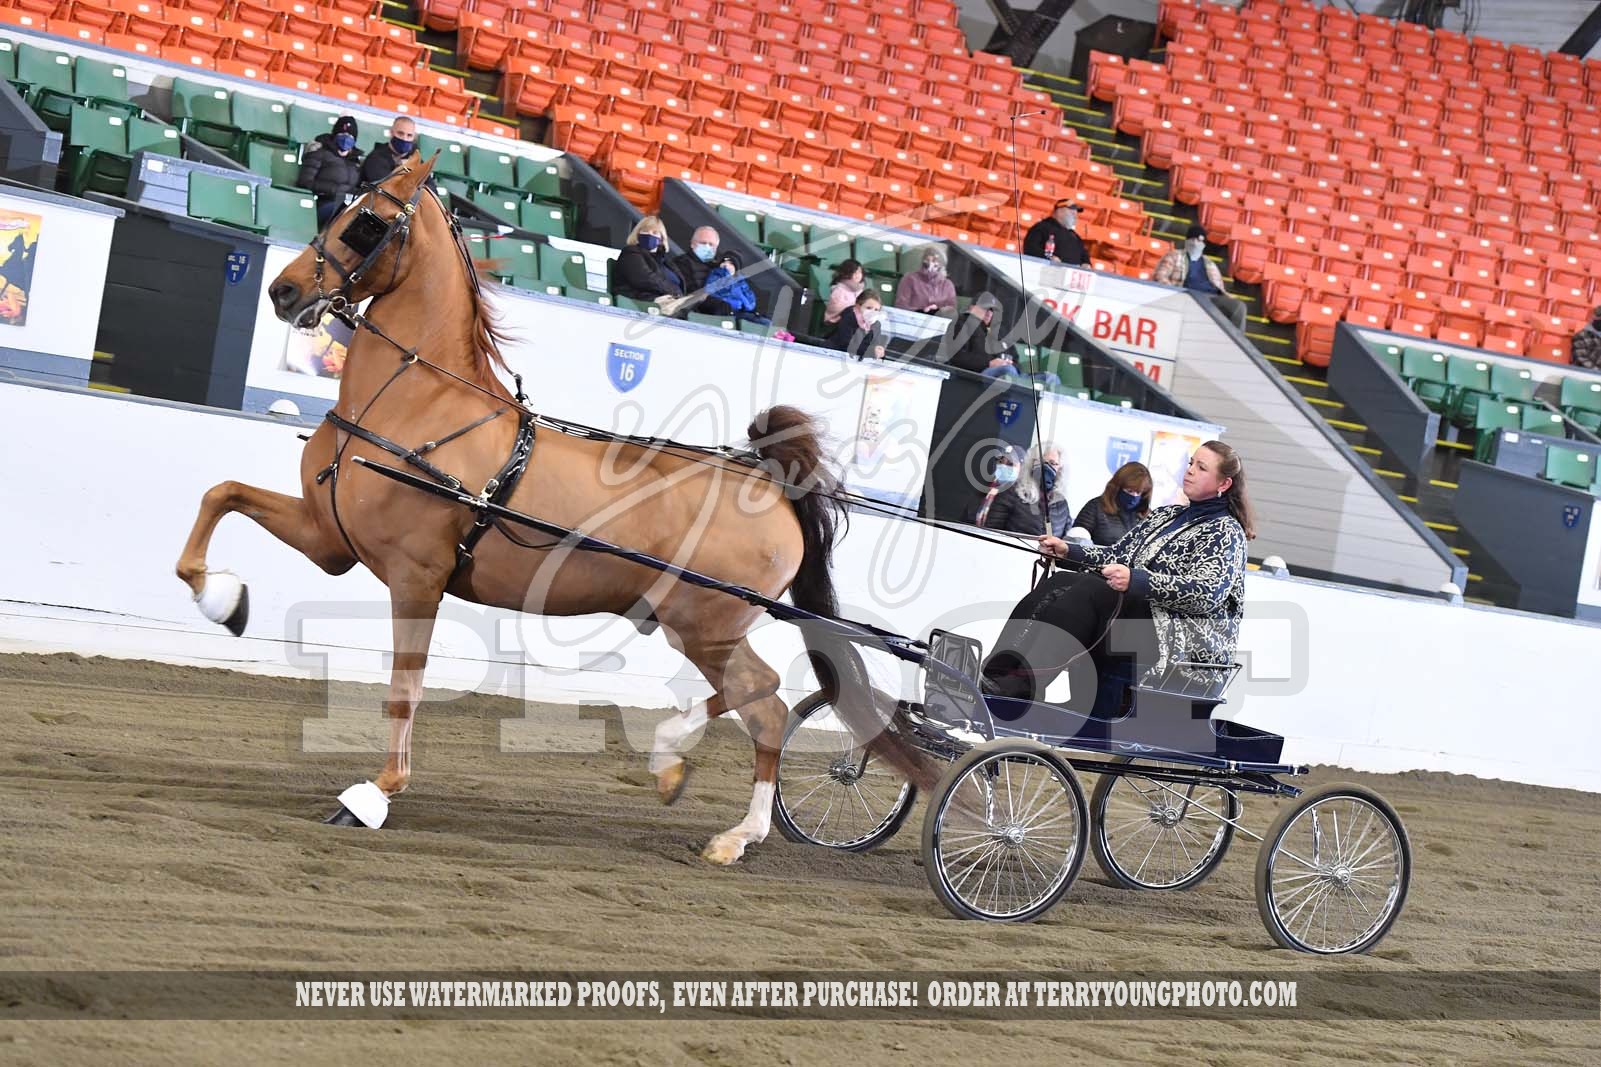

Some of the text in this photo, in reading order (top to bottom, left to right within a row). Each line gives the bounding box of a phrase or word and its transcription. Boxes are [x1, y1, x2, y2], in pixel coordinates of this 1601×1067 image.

[1092, 308, 1158, 350] BAR
[613, 348, 645, 361] SECTION
[620, 362, 635, 382] 16
